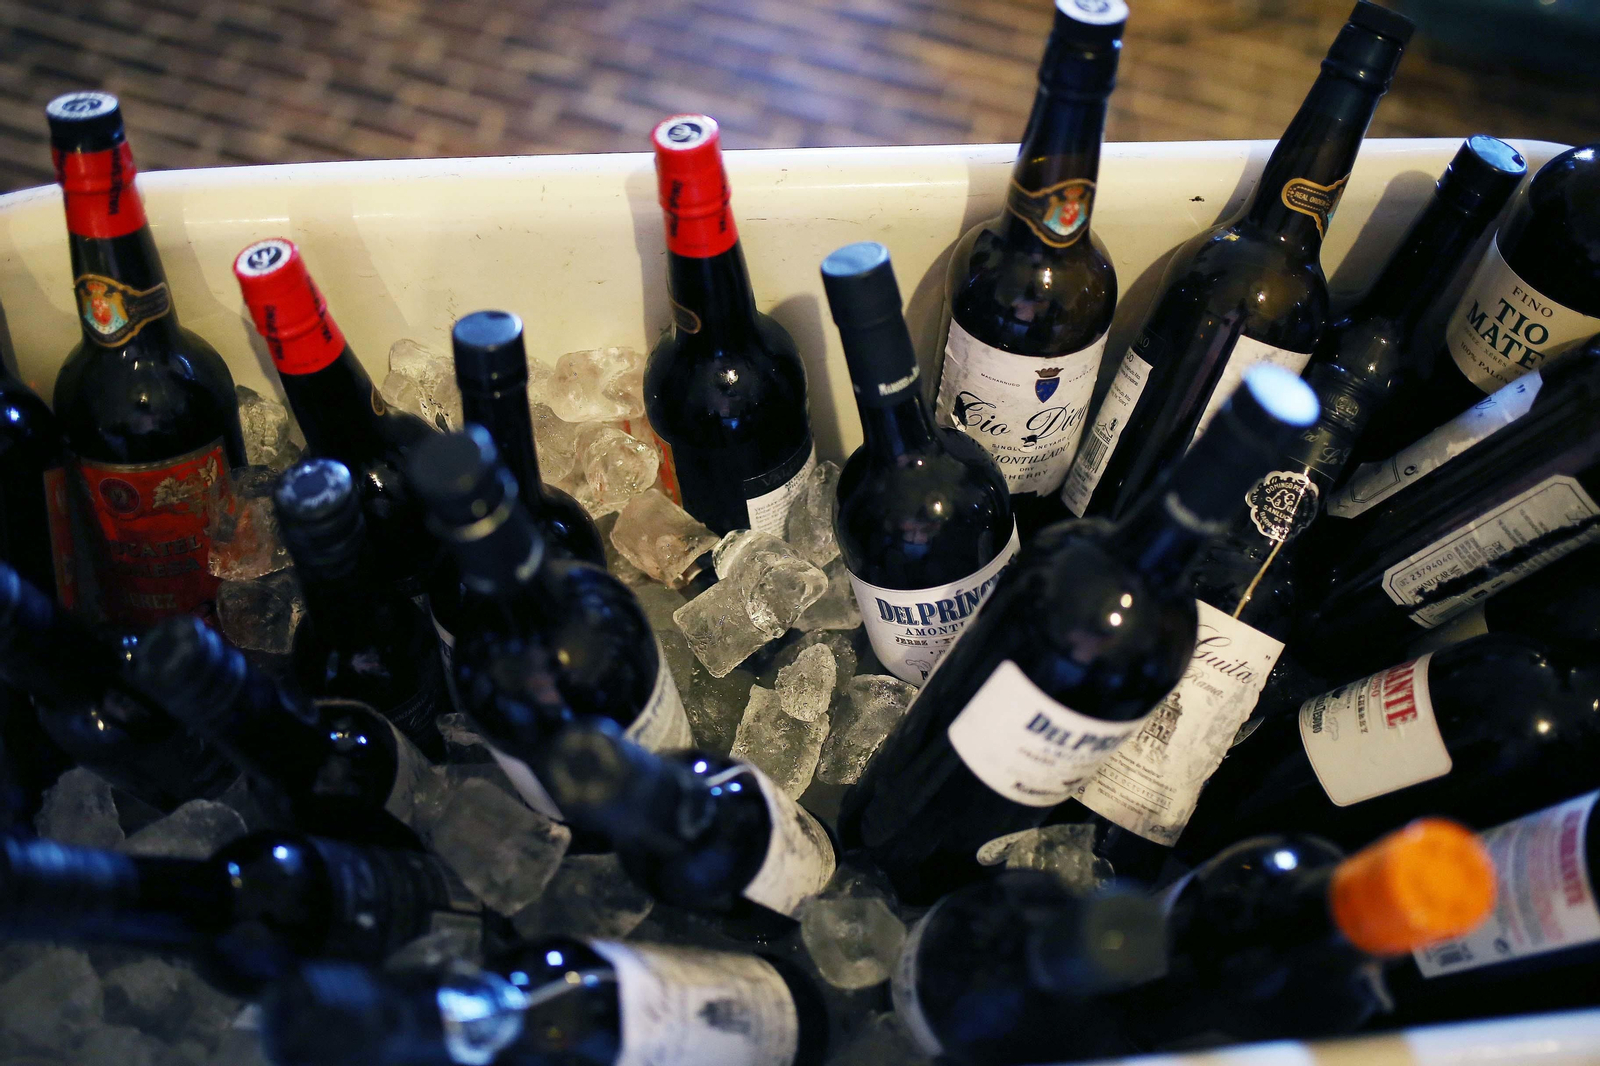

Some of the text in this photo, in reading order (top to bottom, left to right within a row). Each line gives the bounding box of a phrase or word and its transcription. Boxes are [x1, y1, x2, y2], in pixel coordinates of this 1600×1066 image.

[1512, 285, 1554, 318] FINO
[1494, 297, 1549, 345] TIO
[1466, 299, 1546, 371] MATE
[980, 372, 1021, 388] MACHARNUDO
[955, 390, 1089, 441] Tio Dieg
[990, 441, 1071, 466] MONTILLADO
[991, 436, 1067, 452] SINGL INEYARD
[1264, 482, 1293, 494] DOMINGO
[895, 636, 929, 647] JEREZ
